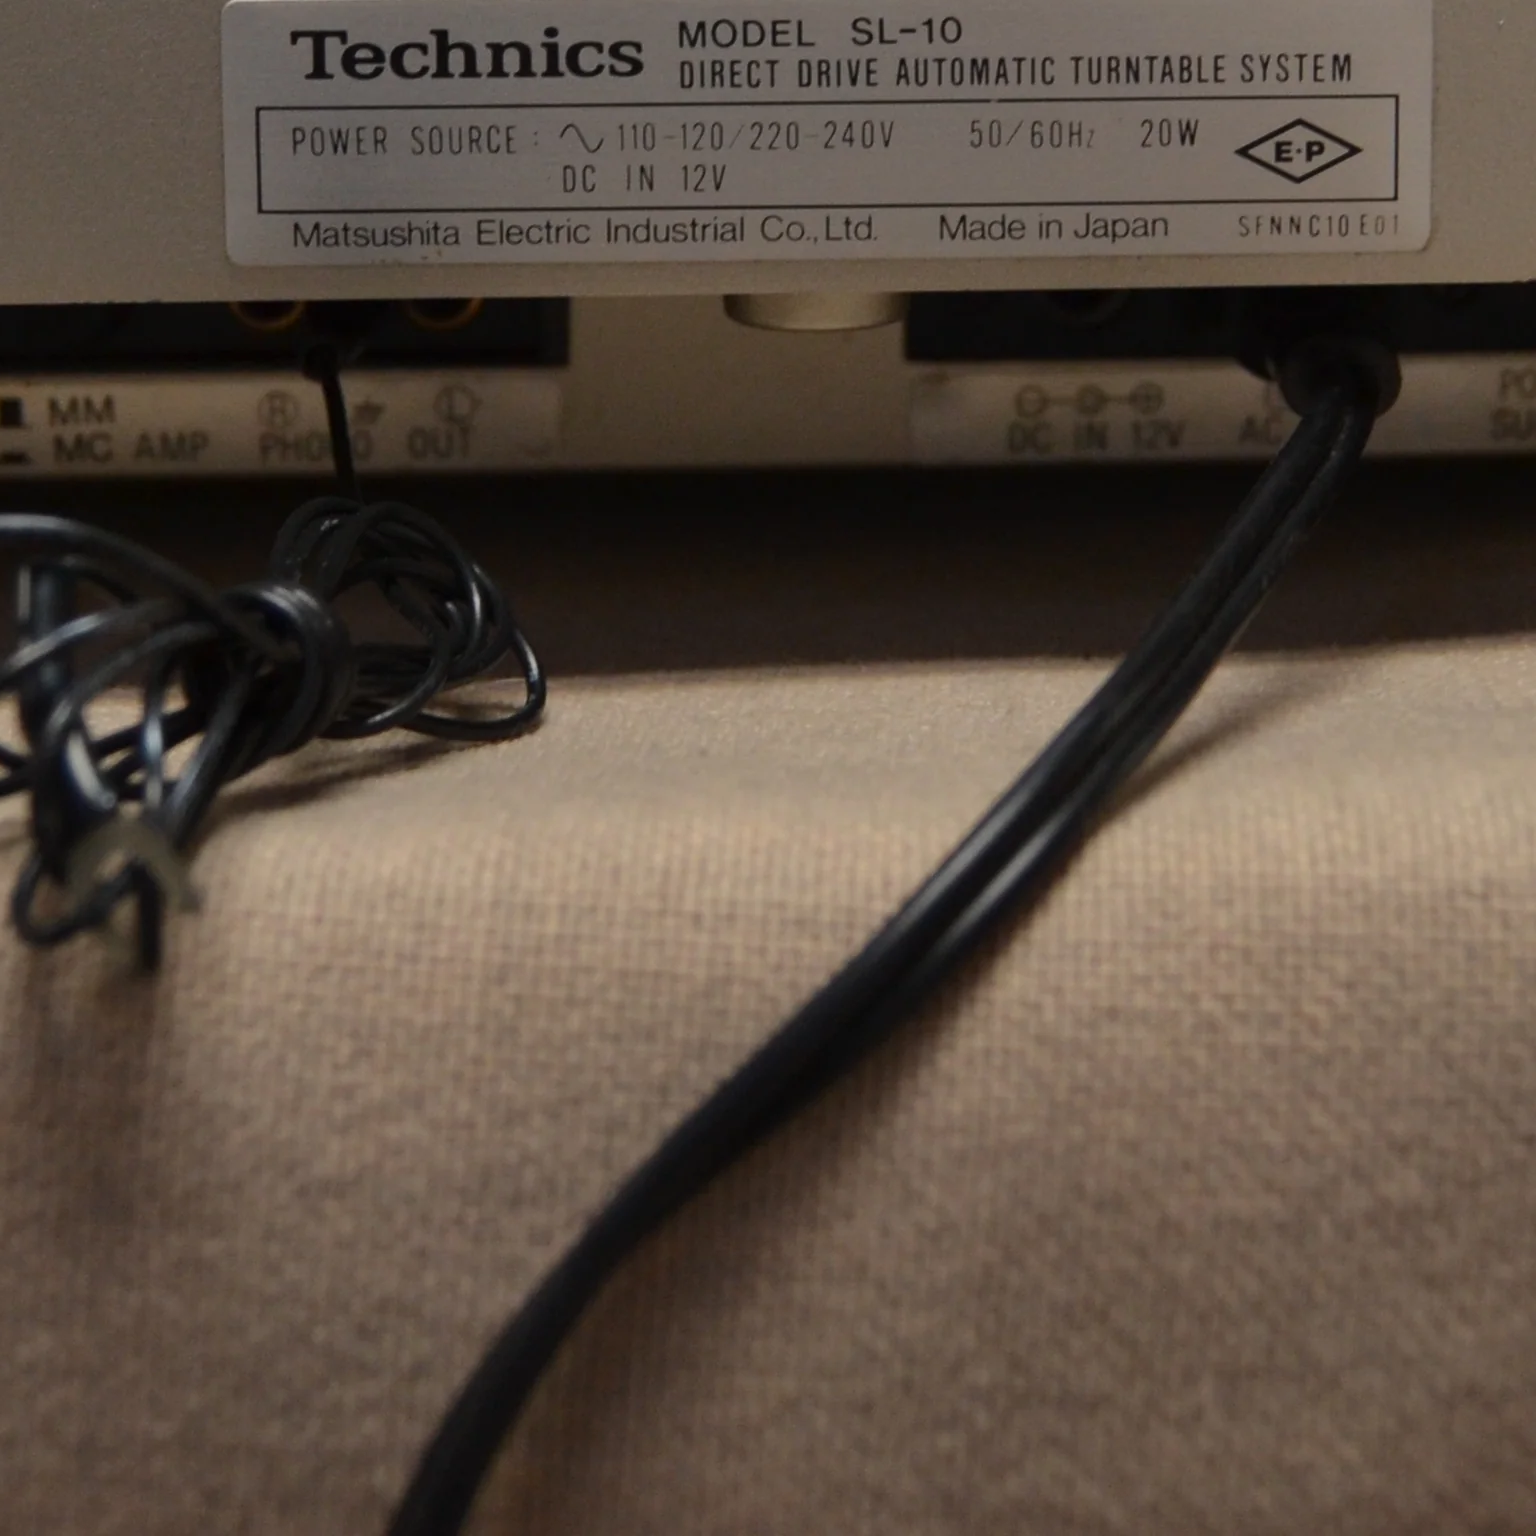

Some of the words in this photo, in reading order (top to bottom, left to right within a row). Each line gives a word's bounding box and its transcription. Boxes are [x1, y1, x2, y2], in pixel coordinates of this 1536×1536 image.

[677, 18, 816, 49] MODEL
[850, 16, 962, 46] SL-10
[290, 26, 644, 80] Technics
[679, 59, 780, 90] DIRECT
[798, 58, 879, 88] DRIVE
[895, 57, 1055, 87] AUTOMATIC
[1070, 55, 1226, 86] TURNTABLE
[1240, 53, 1352, 84] SYSTEM
[291, 125, 388, 156] POWER
[1140, 117, 1200, 148] 20W
[562, 164, 598, 194] DC
[626, 164, 656, 193] IN
[682, 163, 728, 193] 12V
[292, 219, 461, 248] Matsushita
[476, 217, 591, 246] Electric
[605, 215, 745, 244] Industrial
[938, 214, 1027, 241] Made
[1038, 213, 1063, 240] in
[1074, 213, 1170, 245] Japan
[47, 396, 116, 424] MM
[51, 434, 114, 463] MC
[133, 432, 208, 460] AMP
[260, 430, 372, 460] PHOO
[407, 426, 474, 458] OUT
[1008, 420, 1052, 453] DC
[1076, 419, 1107, 451] IN
[1133, 417, 1184, 451] 12V
